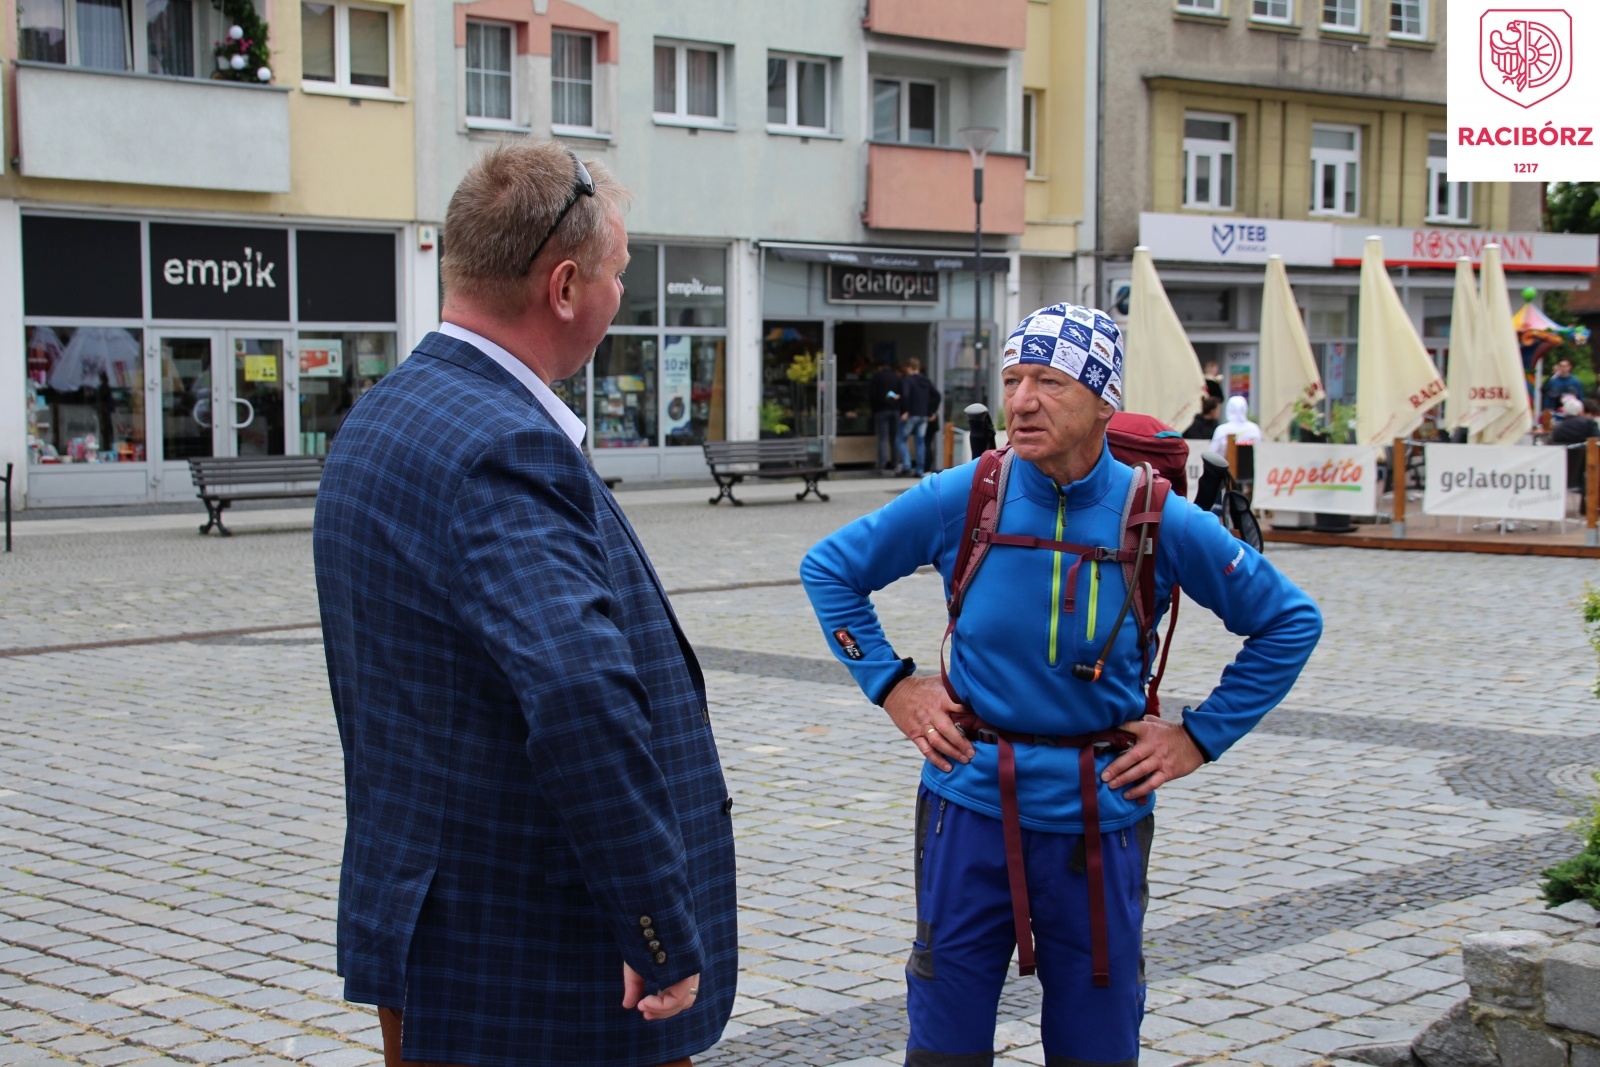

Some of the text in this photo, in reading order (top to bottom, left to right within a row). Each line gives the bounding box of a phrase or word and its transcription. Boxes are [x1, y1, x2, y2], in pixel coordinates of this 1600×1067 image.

[1238, 225, 1266, 241] TEB
[163, 246, 276, 293] empik
[667, 278, 723, 297] empik.com
[842, 270, 935, 299] gelatopiu
[1267, 458, 1362, 496] appetito
[1440, 467, 1551, 494] gelatopiu
